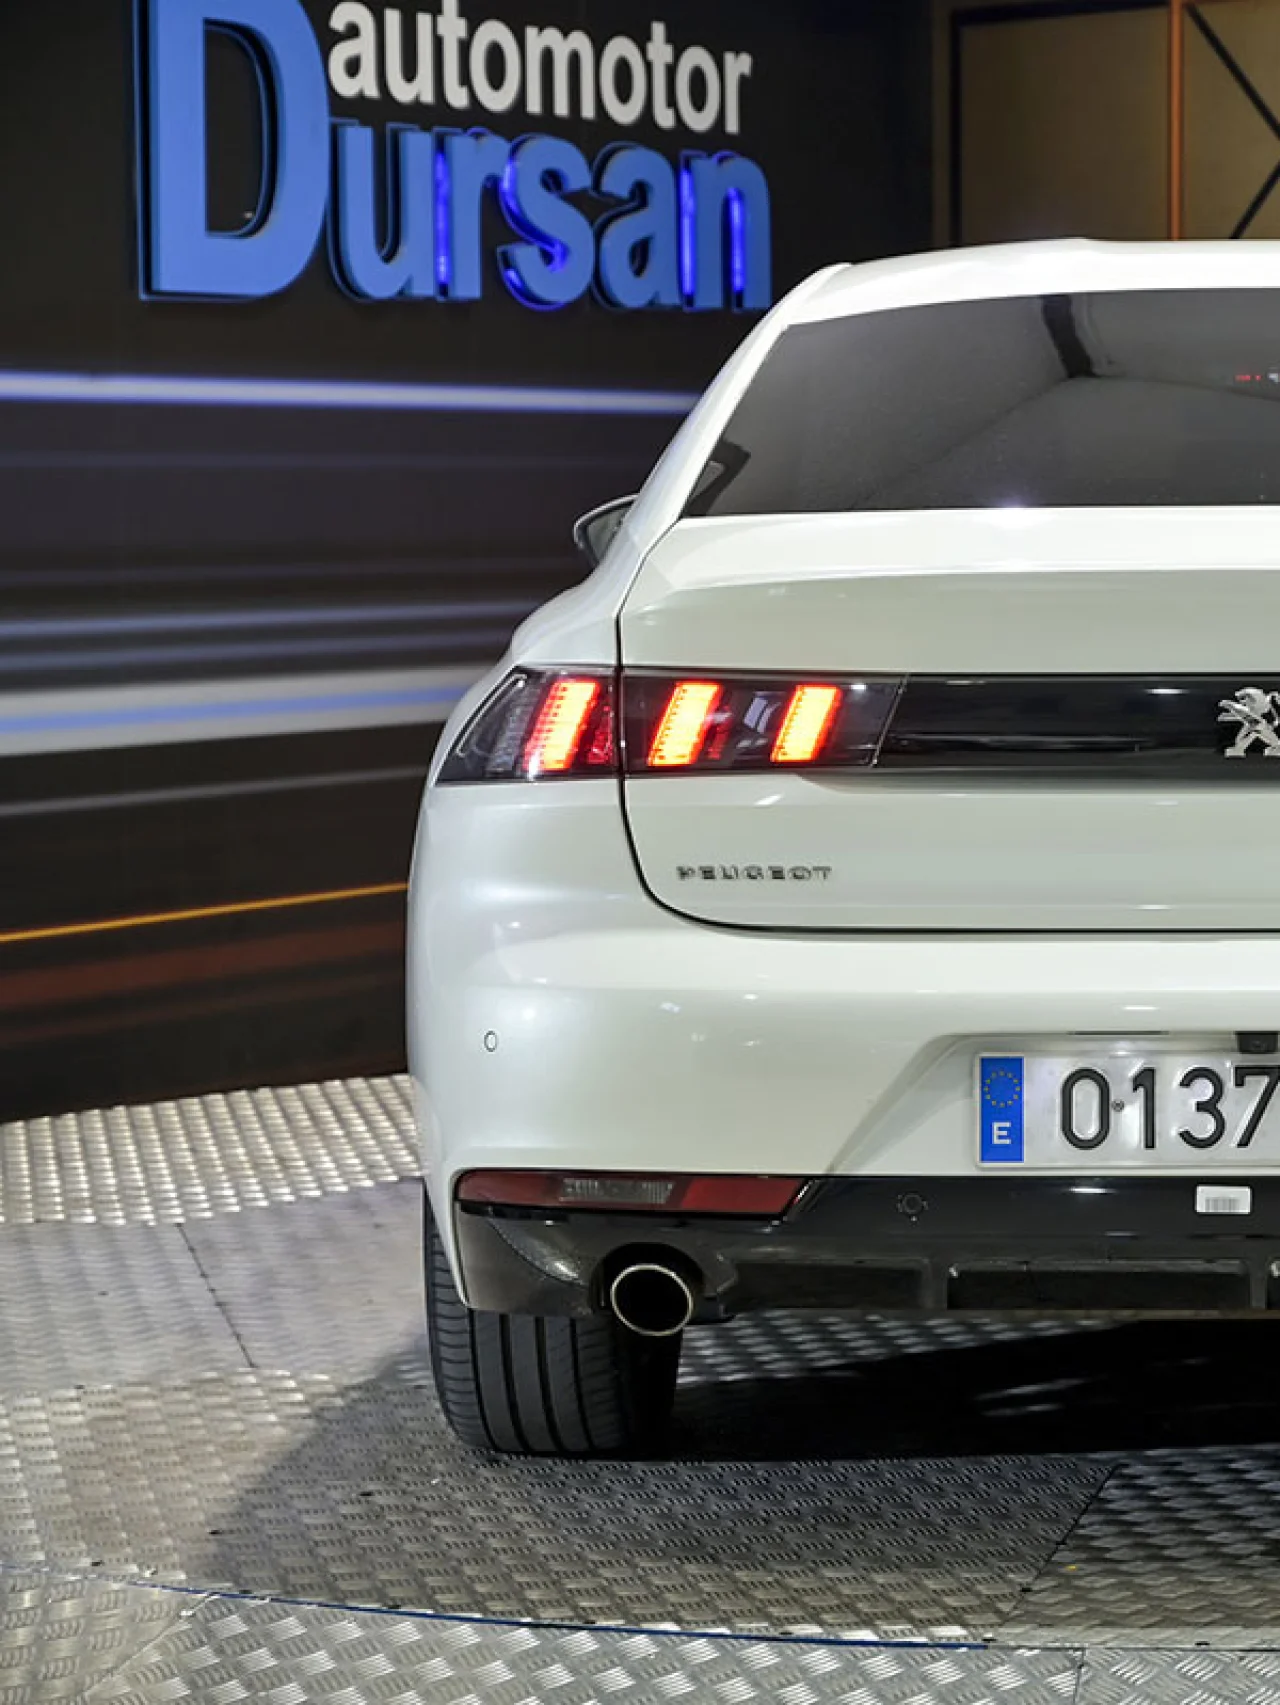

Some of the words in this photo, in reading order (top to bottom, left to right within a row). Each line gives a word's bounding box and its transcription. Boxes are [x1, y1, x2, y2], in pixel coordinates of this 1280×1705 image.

[327, 0, 752, 135] automotor
[138, 0, 771, 310] Dursan
[676, 865, 833, 881] PEUGEOT
[991, 1122, 1012, 1145] E
